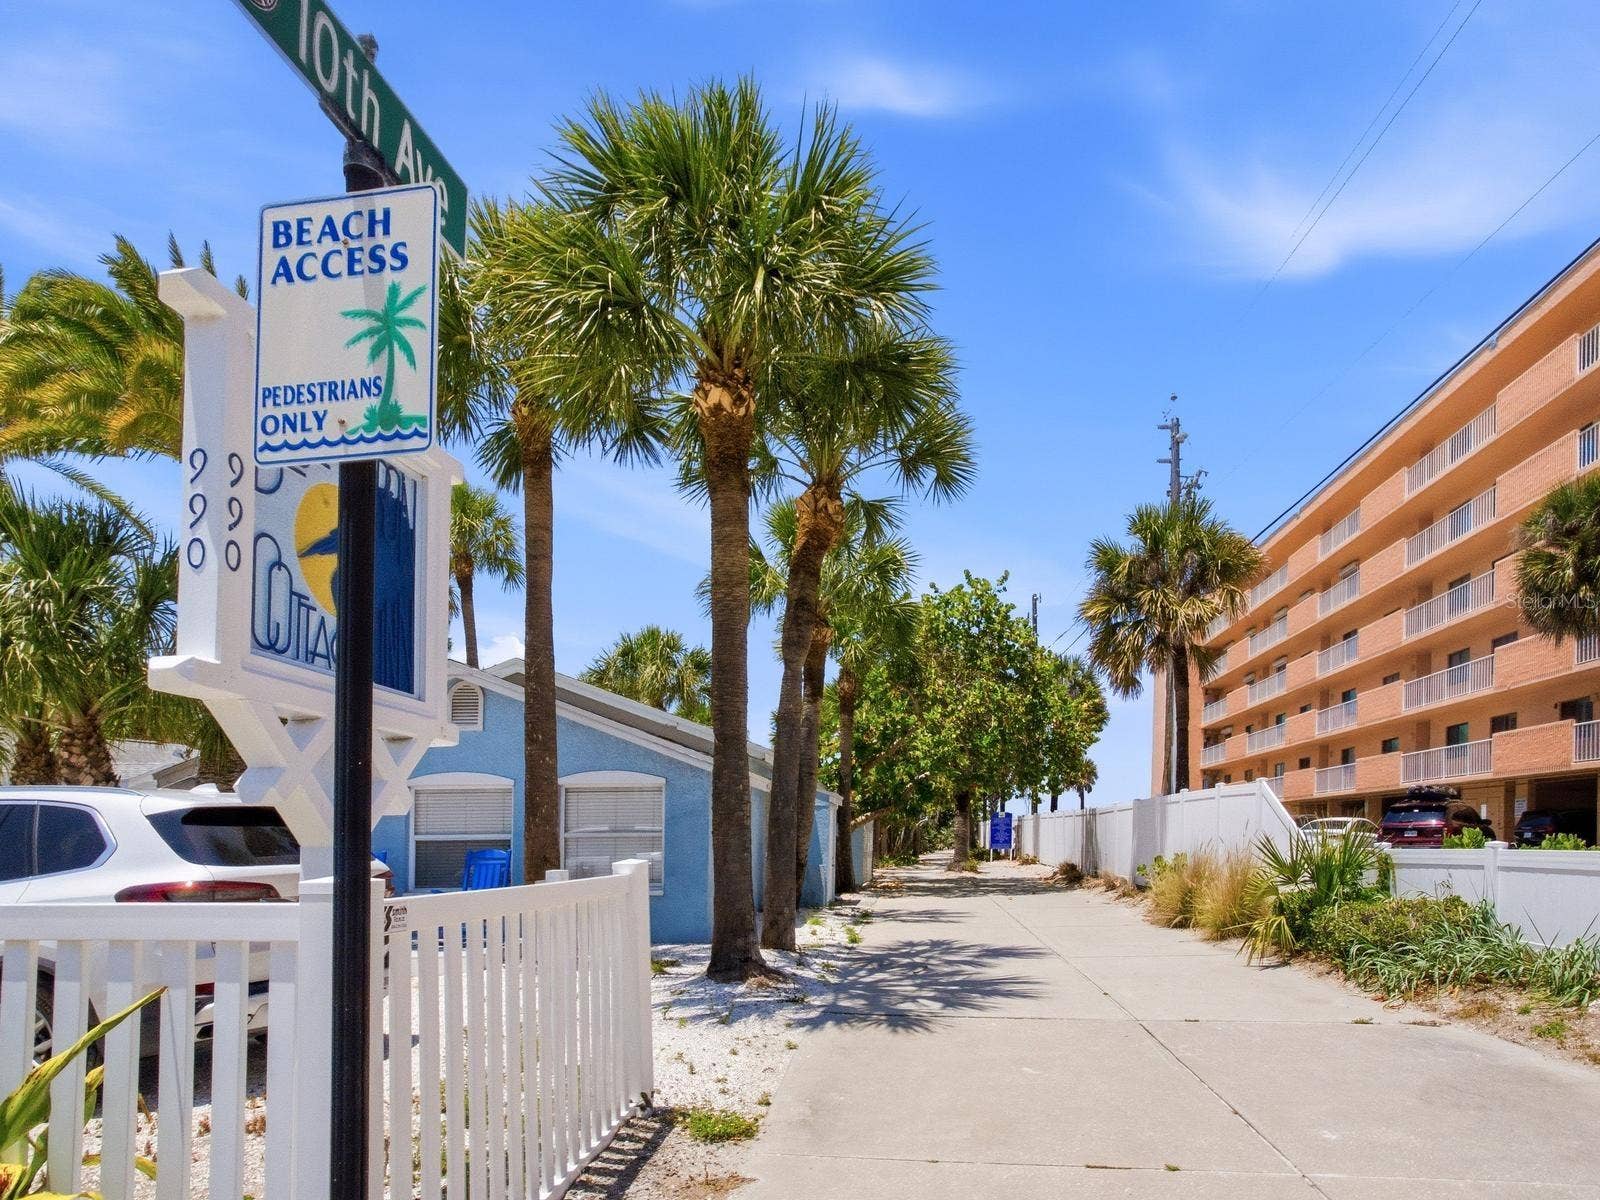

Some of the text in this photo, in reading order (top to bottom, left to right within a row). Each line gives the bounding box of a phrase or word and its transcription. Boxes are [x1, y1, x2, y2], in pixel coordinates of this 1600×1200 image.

[299, 0, 380, 150] 10th
[271, 207, 391, 249] BEACH
[270, 241, 409, 285] ACCESS
[261, 375, 384, 409] PEDESTRIANS
[260, 409, 329, 437] ONLY
[187, 447, 208, 570] 990
[225, 452, 244, 572] 990
